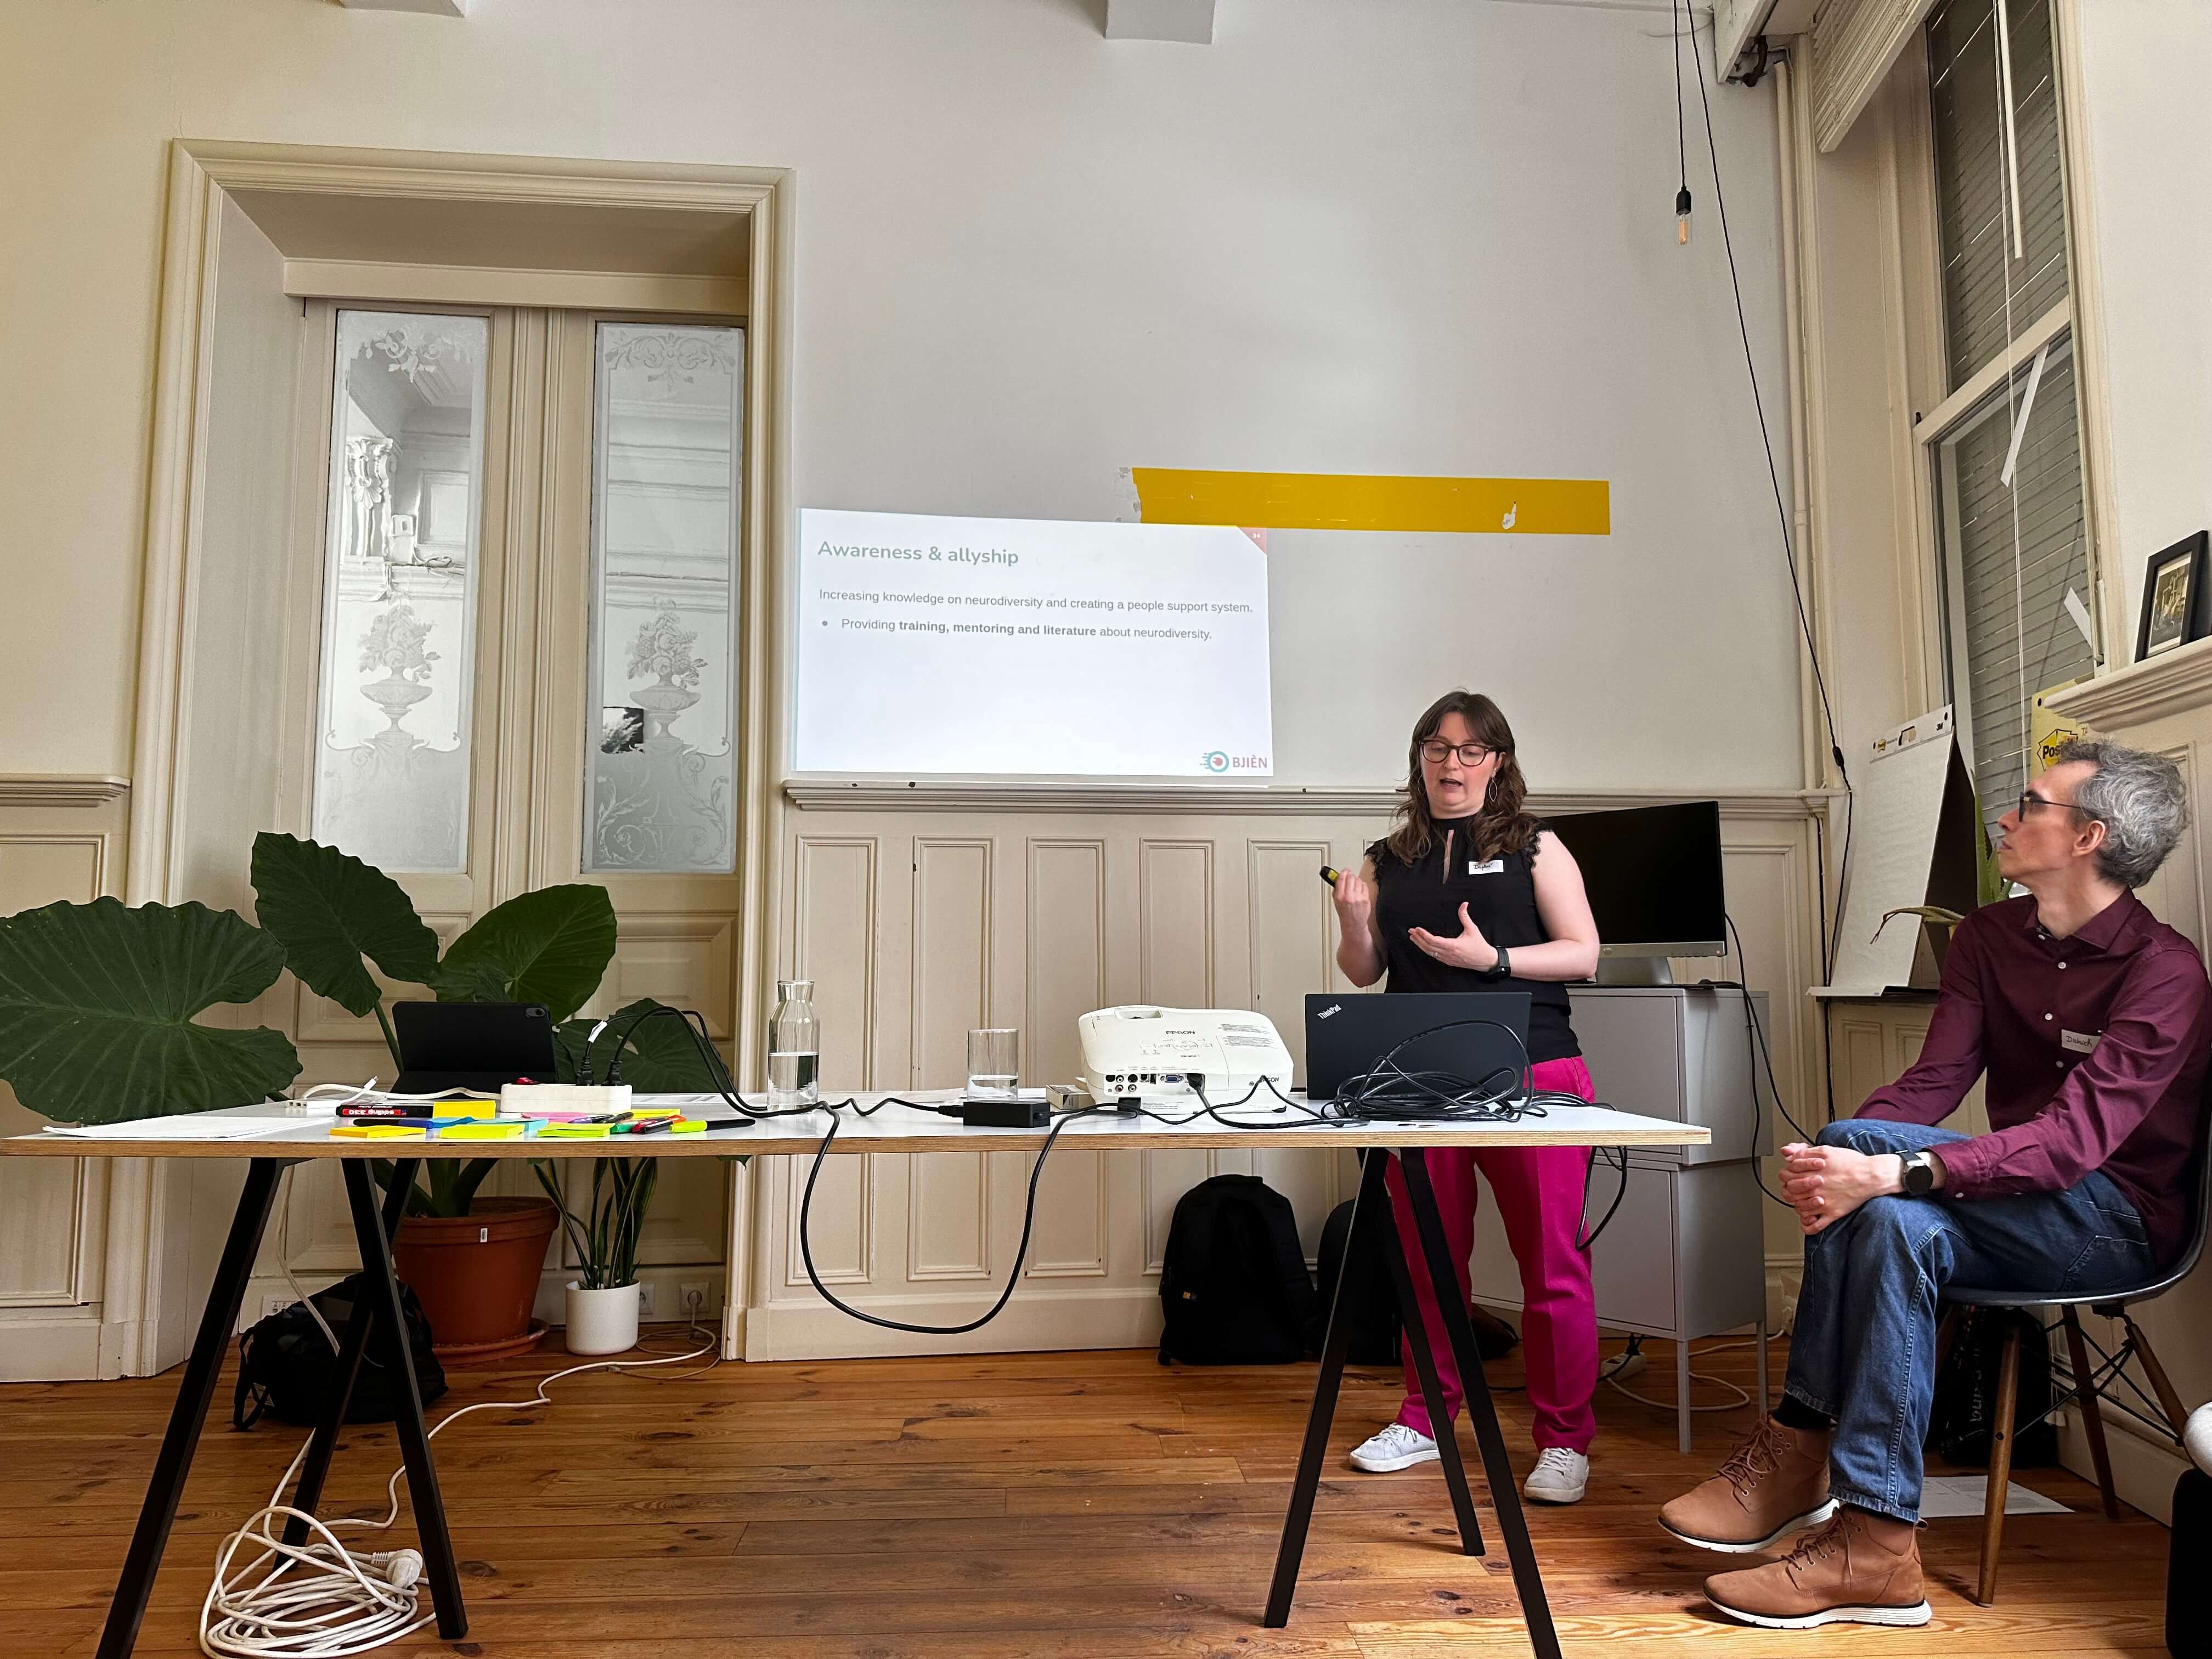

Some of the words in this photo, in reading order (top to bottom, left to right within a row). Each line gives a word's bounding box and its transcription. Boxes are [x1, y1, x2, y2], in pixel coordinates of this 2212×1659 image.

[817, 541, 922, 560] Awareness
[928, 546, 942, 561] &
[948, 548, 1019, 567] allyship
[820, 589, 879, 603] Increasing
[883, 591, 944, 605] knowledge
[947, 596, 961, 605] on
[965, 596, 1043, 609] neurodiversity
[1046, 598, 1067, 607] and
[1070, 599, 1114, 611] creating
[1117, 601, 1124, 610] a
[1127, 601, 1164, 612] people
[1167, 602, 1208, 613] support
[1211, 603, 1253, 614] system.
[842, 618, 895, 632] Providing
[899, 621, 950, 633] training,
[953, 623, 1014, 635] mentoring
[1018, 625, 1040, 635] and
[1043, 625, 1097, 636] literature
[1099, 627, 1131, 637] about
[1134, 628, 1212, 641] neurodiversity.
[1233, 754, 1267, 769] BJIÈN
[1317, 1004, 1342, 1019] ThinkPad
